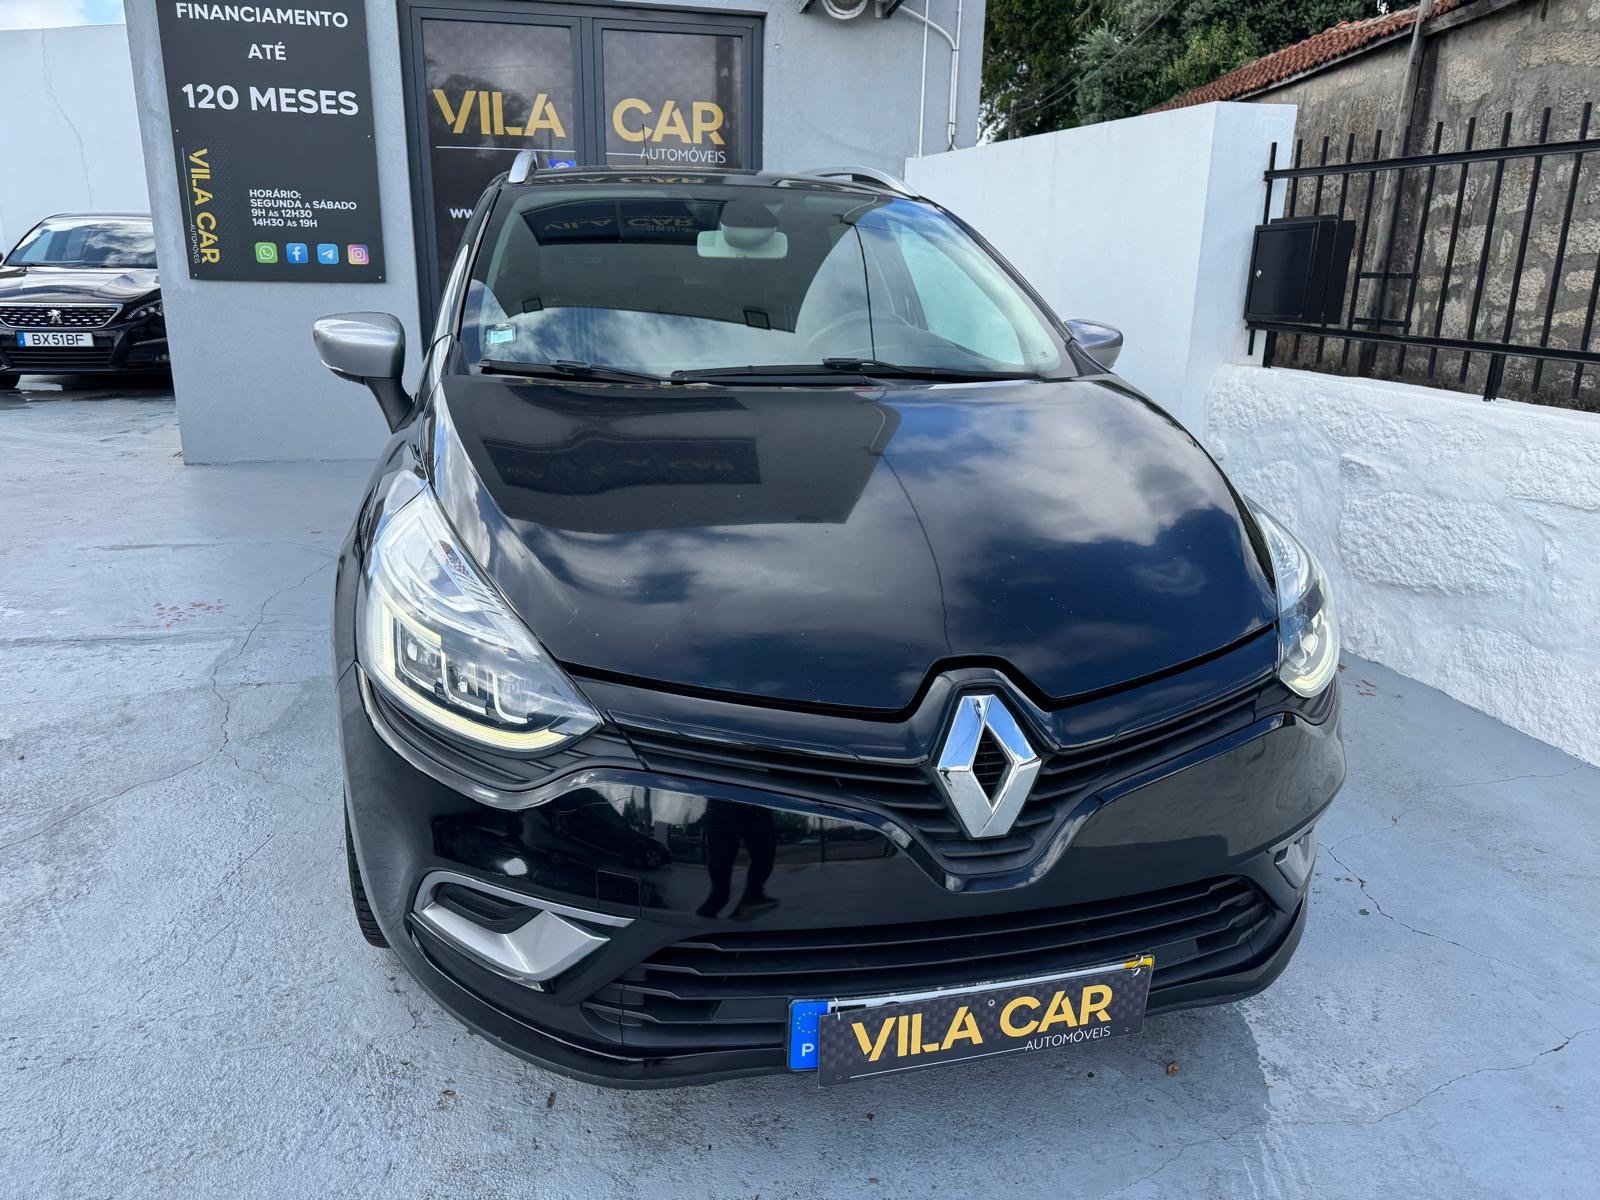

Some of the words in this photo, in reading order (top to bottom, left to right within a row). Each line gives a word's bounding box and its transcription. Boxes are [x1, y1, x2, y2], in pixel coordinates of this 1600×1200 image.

[175, 2, 349, 28] FINANCIAMENTO
[248, 42, 287, 61] ATÉ
[181, 83, 239, 110] 120
[249, 86, 359, 116] MESES
[432, 88, 566, 138] VILA
[612, 97, 725, 145] CAR
[640, 146, 727, 164] AUTOMÓVEIS
[189, 148, 213, 206] VILA
[249, 188, 302, 199] HORÁRIO:
[250, 199, 302, 208] SEGUNDA
[312, 199, 357, 210] SÁBADO
[251, 208, 266, 217] 9H
[281, 209, 313, 218] 12H30
[252, 218, 284, 227] 14H30
[299, 219, 318, 228] 19H
[196, 212, 220, 264] CAR
[852, 1006, 983, 1062] VILA
[999, 984, 1112, 1038] CAR
[1024, 1025, 1111, 1052] AUTOMÓVEIS
[801, 1043, 815, 1057] P
